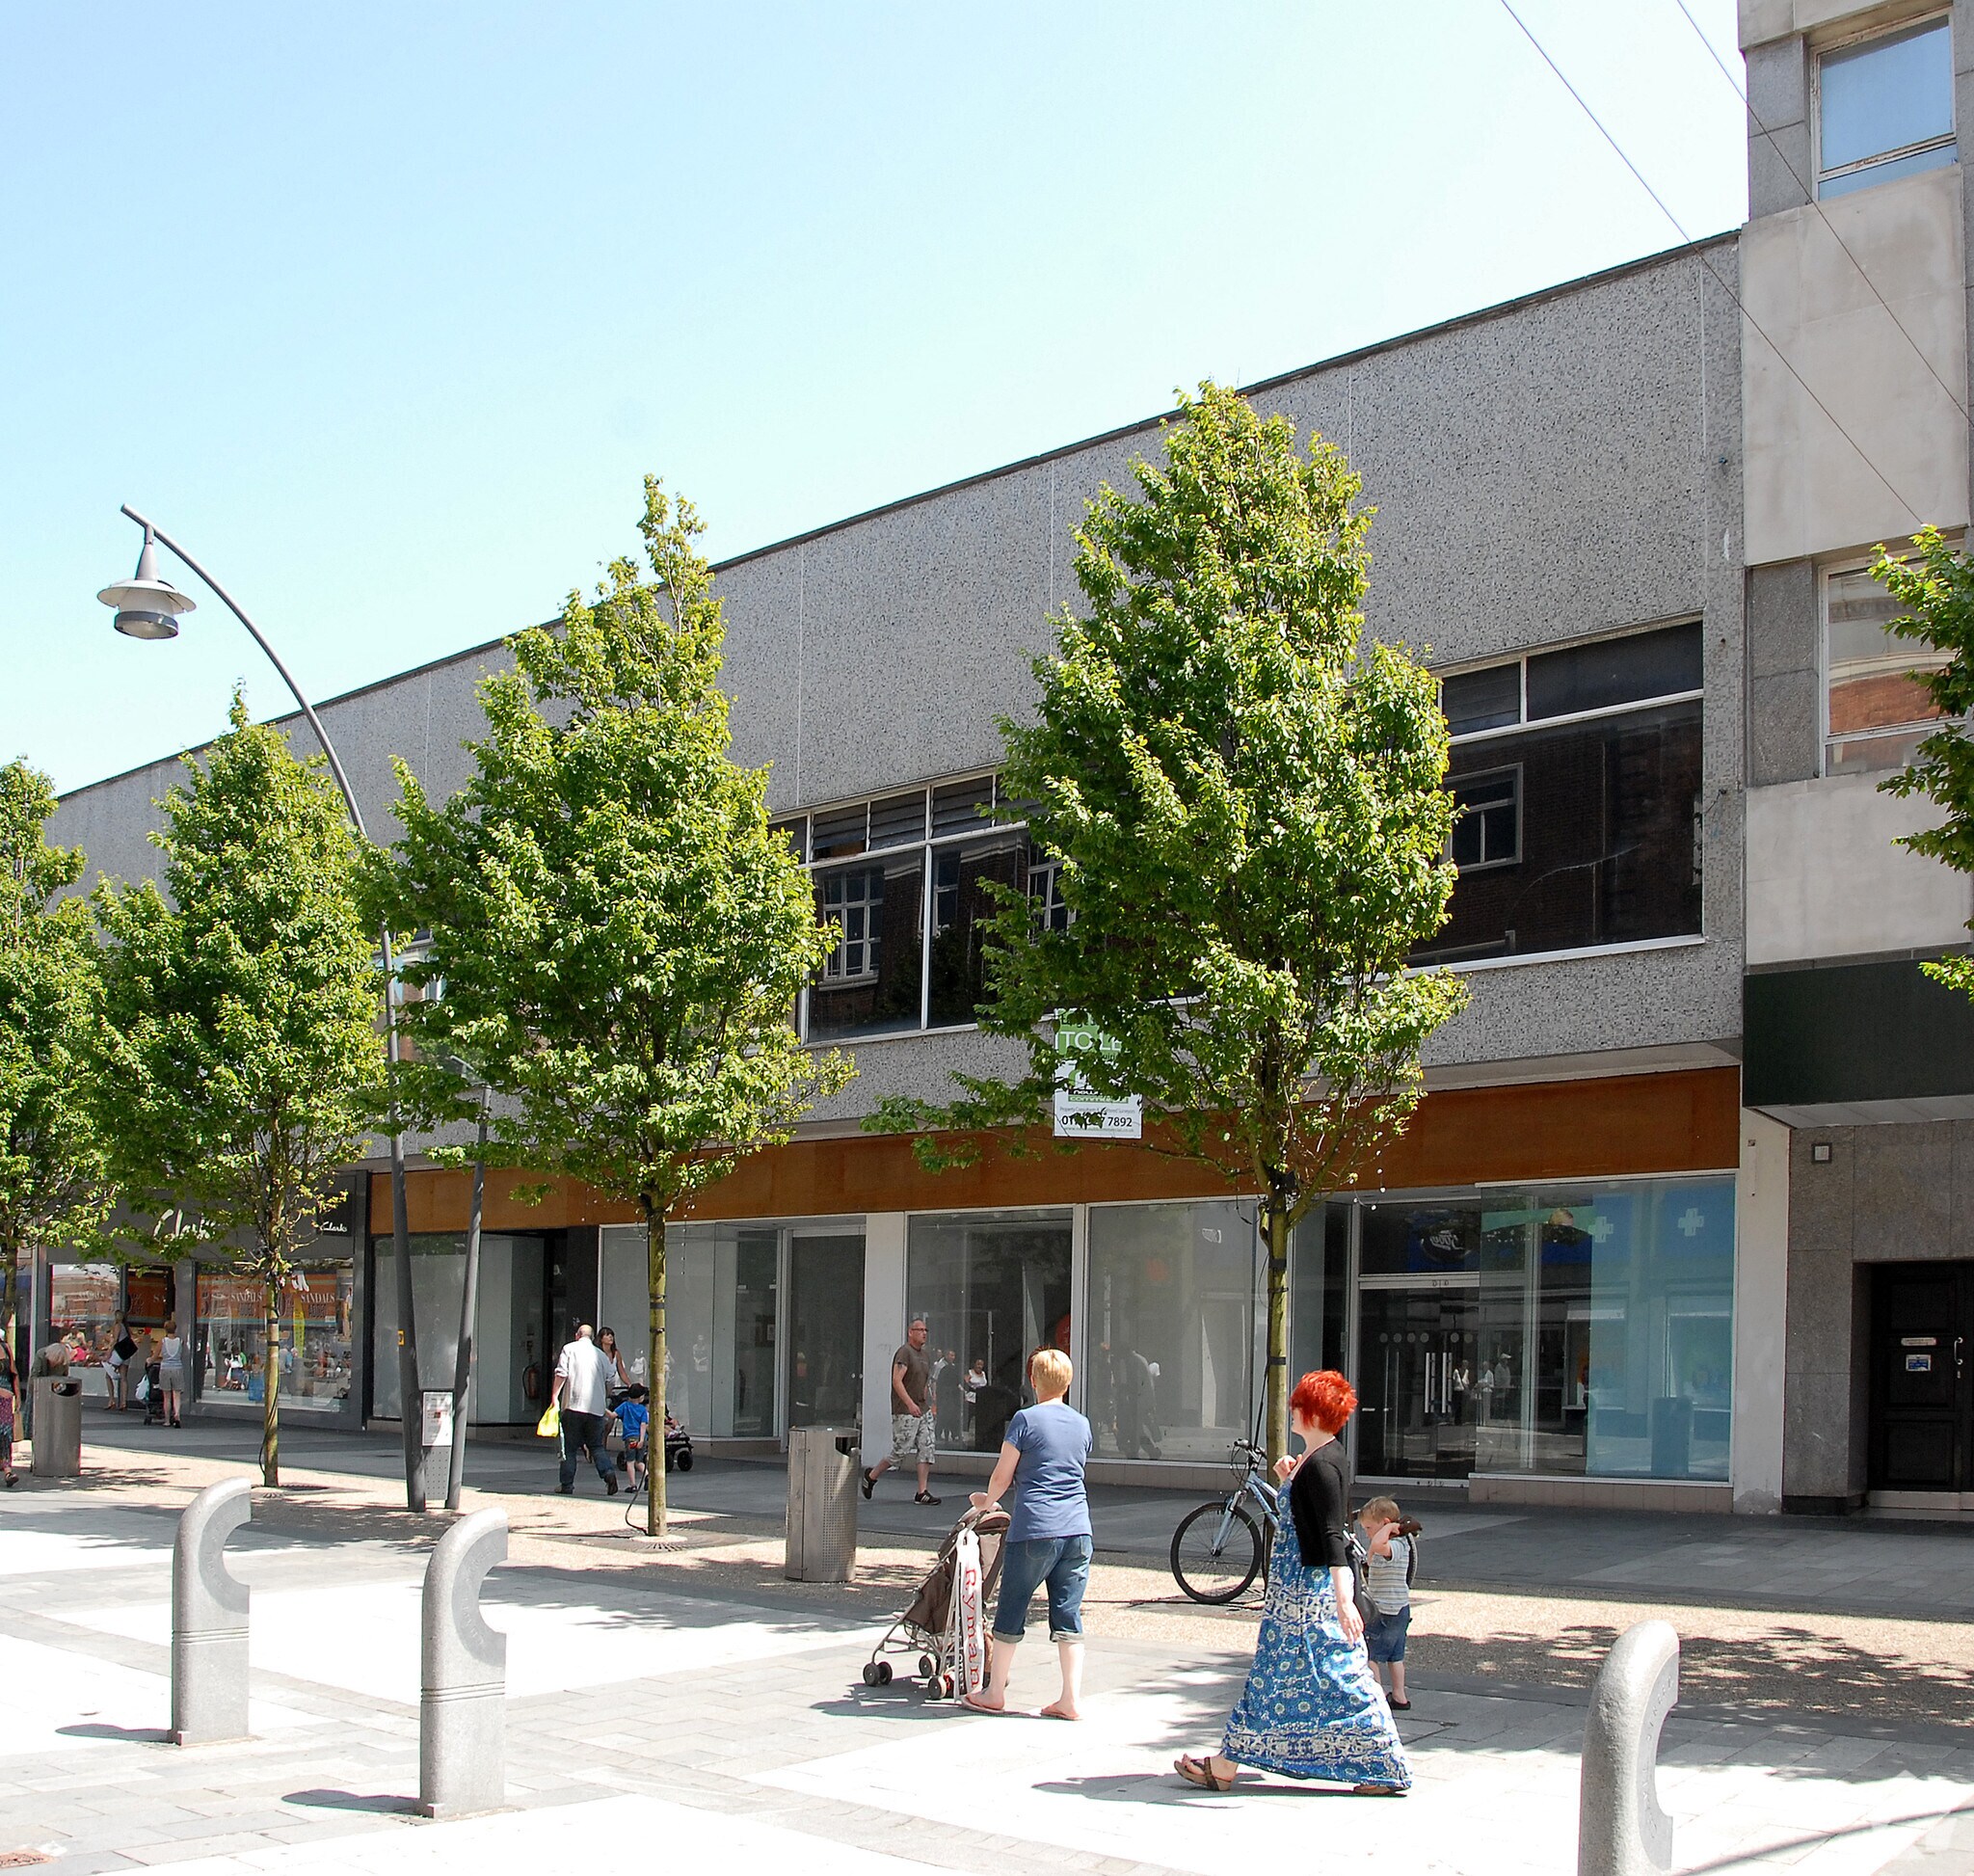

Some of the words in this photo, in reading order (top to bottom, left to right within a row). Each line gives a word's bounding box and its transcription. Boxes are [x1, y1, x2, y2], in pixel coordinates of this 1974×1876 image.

[1060, 1031, 1094, 1050] TO
[1107, 1116, 1133, 1127] 7892
[320, 1220, 348, 1232] Clarks
[230, 1292, 263, 1302] SANDALS
[301, 1292, 335, 1303] SANDALS
[962, 1569, 980, 1688] Ryman
